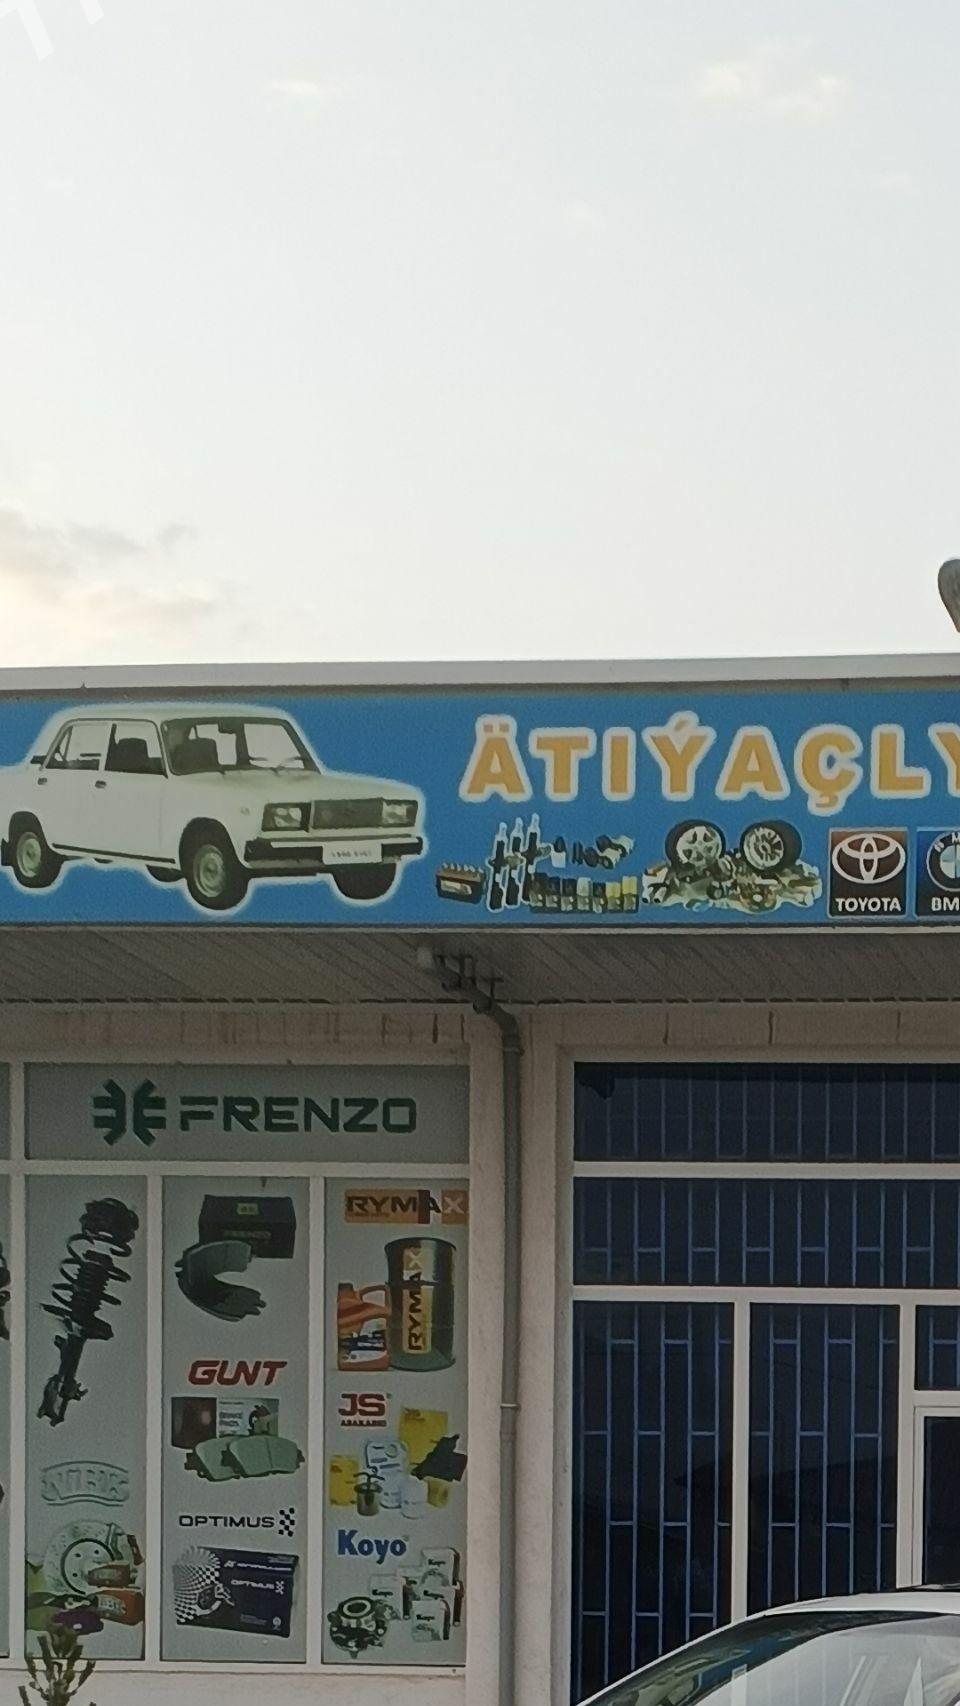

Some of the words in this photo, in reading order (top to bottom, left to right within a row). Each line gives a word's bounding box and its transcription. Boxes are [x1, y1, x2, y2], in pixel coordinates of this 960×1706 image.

[835, 897, 902, 912] TOYOTA
[179, 1096, 417, 1133] FRENZO
[347, 1195, 465, 1214] RYMAX
[188, 1360, 288, 1386] GUNT
[338, 1393, 386, 1416] JS
[179, 1515, 275, 1528] OPTIMUS
[337, 1529, 407, 1565] Koyo
